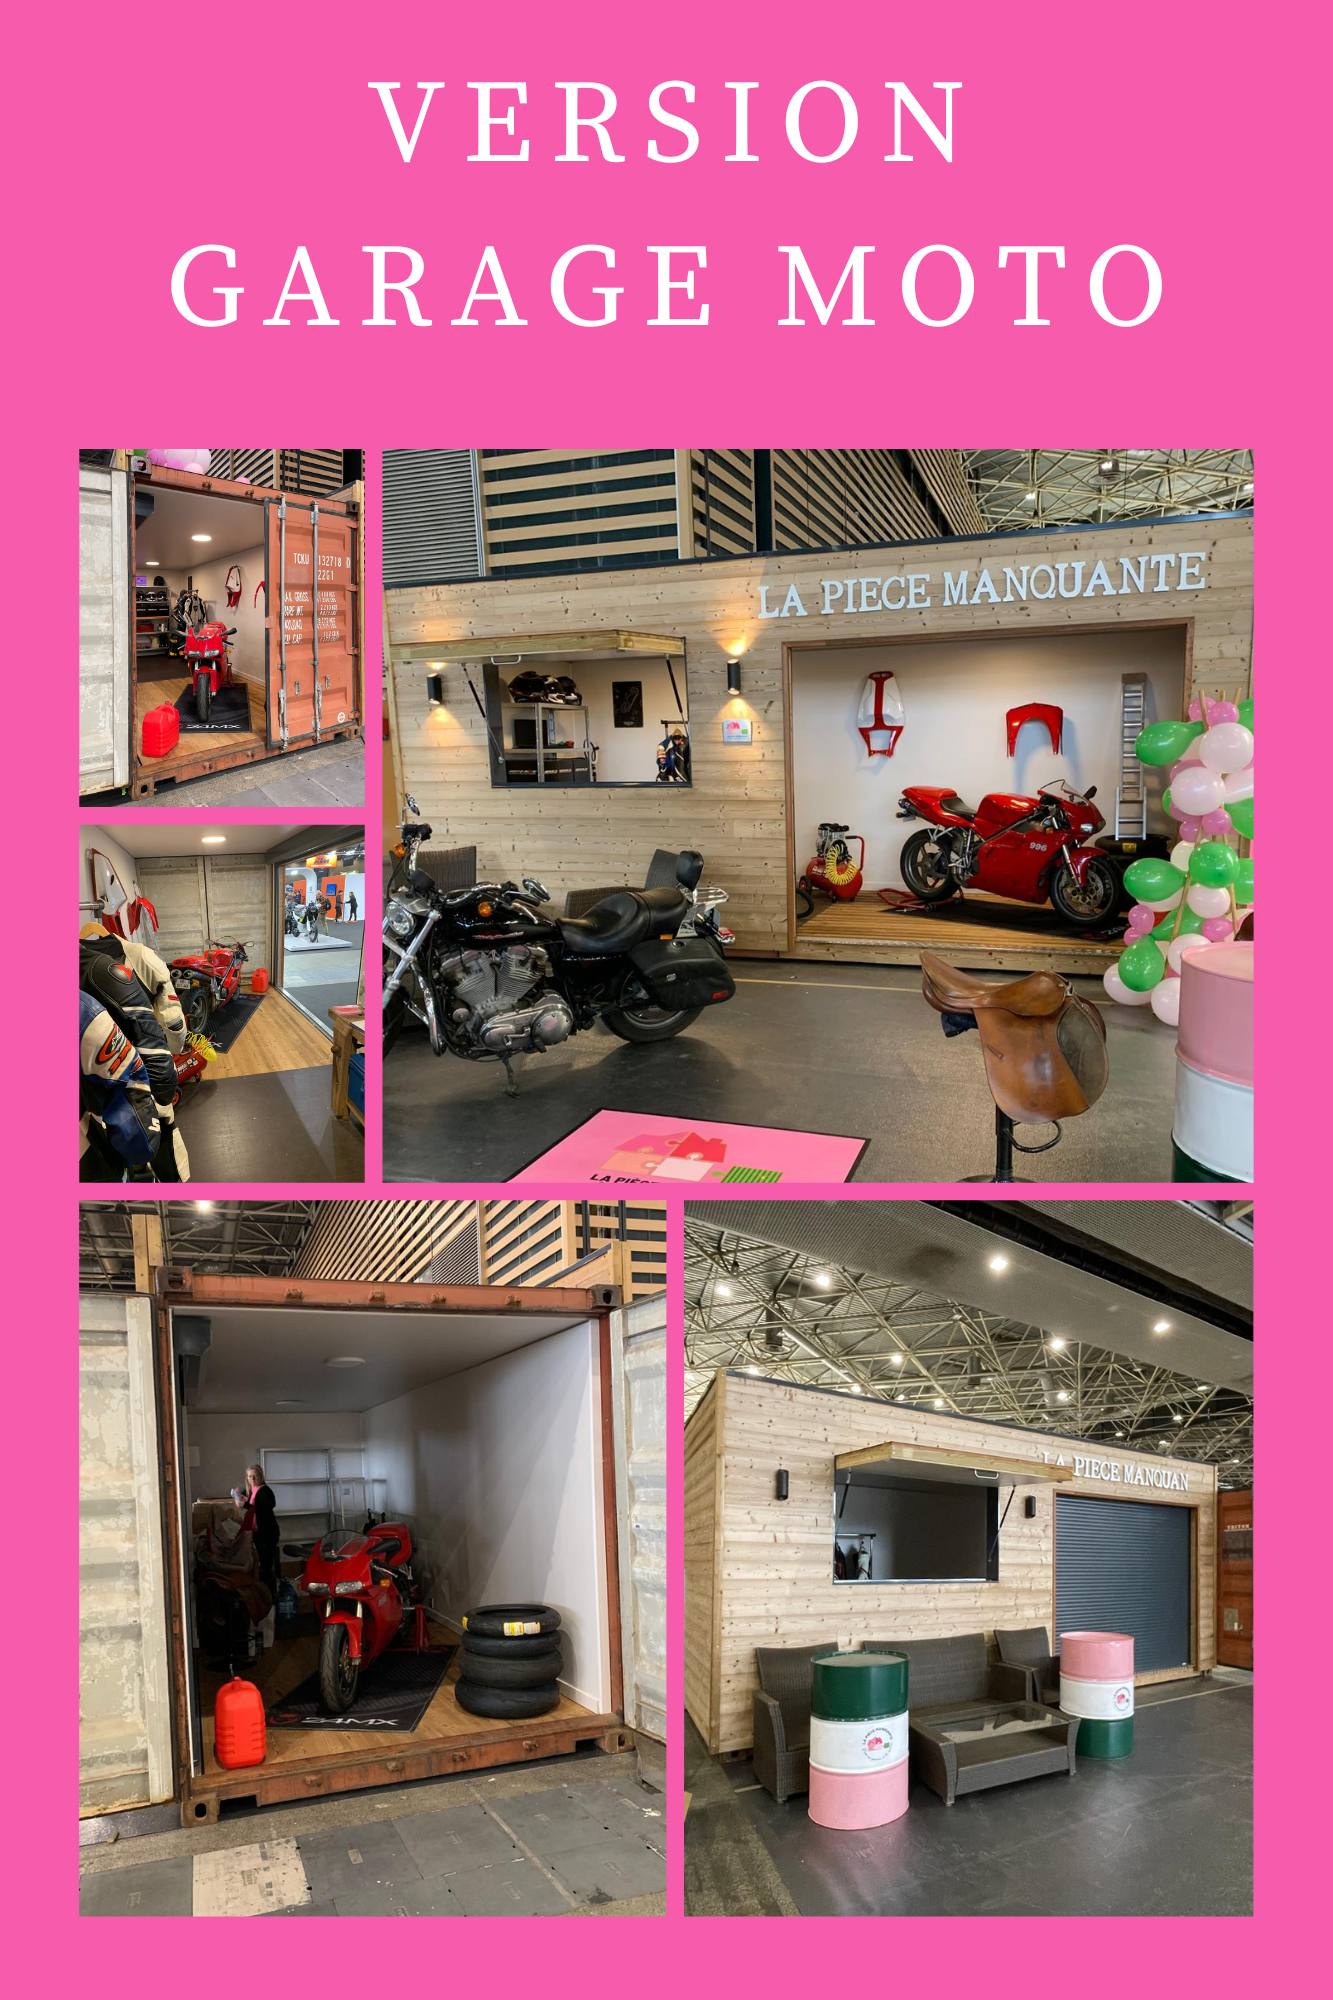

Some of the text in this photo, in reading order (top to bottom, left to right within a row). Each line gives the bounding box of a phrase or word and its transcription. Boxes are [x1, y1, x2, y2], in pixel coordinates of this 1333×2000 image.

[293, 552, 310, 565] TCKU
[318, 555, 342, 568] 132718
[757, 551, 1207, 619] LA PIECE MANQUANTE
[1029, 841, 1048, 852] 996
[590, 1174, 611, 1182] LA
[1073, 1455, 1121, 1482] PIECE
[1123, 1464, 1189, 1491] MANQUAN
